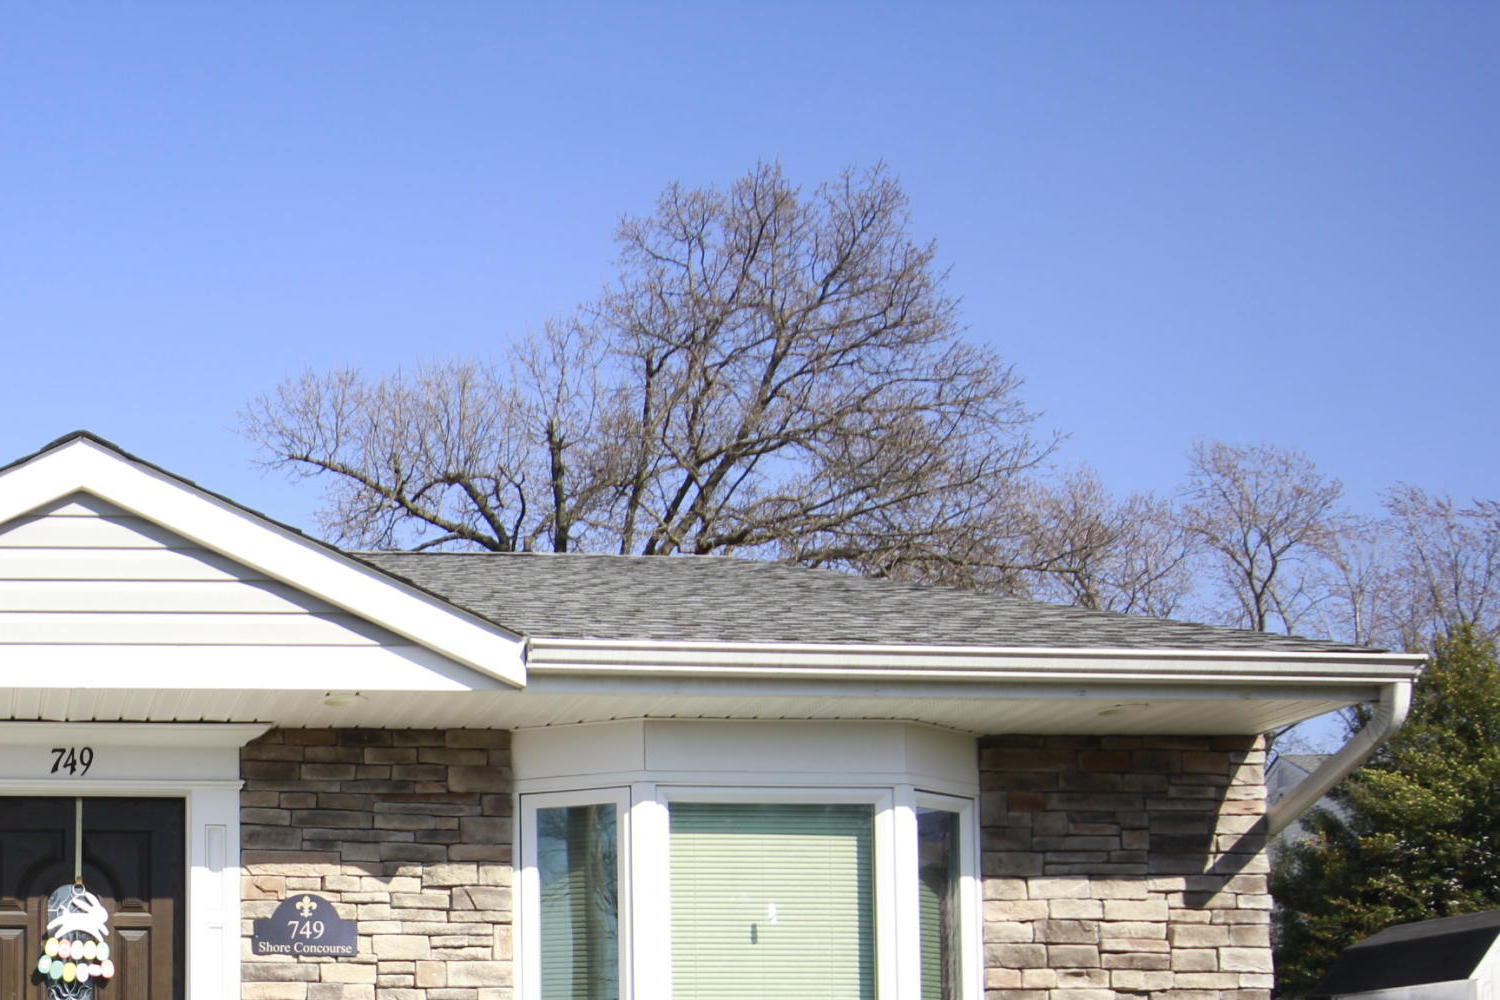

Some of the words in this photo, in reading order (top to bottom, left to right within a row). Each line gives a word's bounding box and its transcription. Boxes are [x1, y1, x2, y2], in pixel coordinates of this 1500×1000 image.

[50, 746, 94, 776] 749
[287, 920, 325, 939] 749
[258, 941, 291, 953] Shore
[293, 941, 353, 954] Concourse
